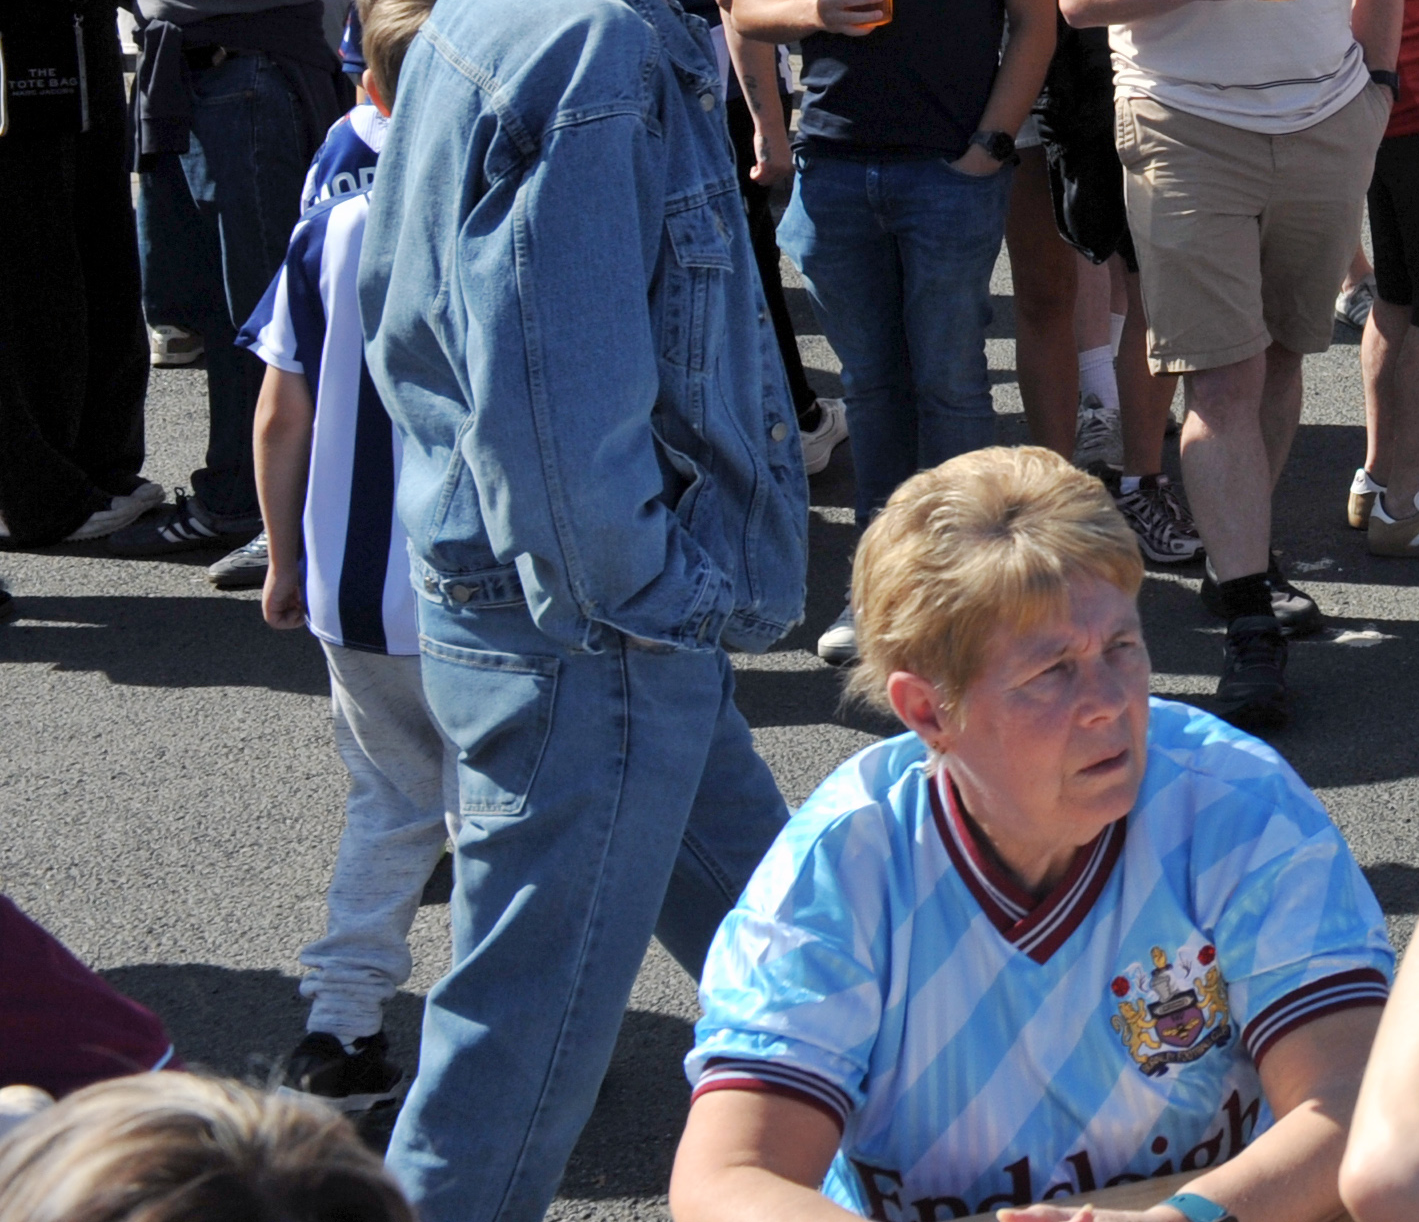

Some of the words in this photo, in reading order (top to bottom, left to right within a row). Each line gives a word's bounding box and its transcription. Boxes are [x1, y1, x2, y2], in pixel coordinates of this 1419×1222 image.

[28, 67, 56, 77] THE
[8, 79, 45, 90] TOTE
[49, 77, 78, 88] BAG
